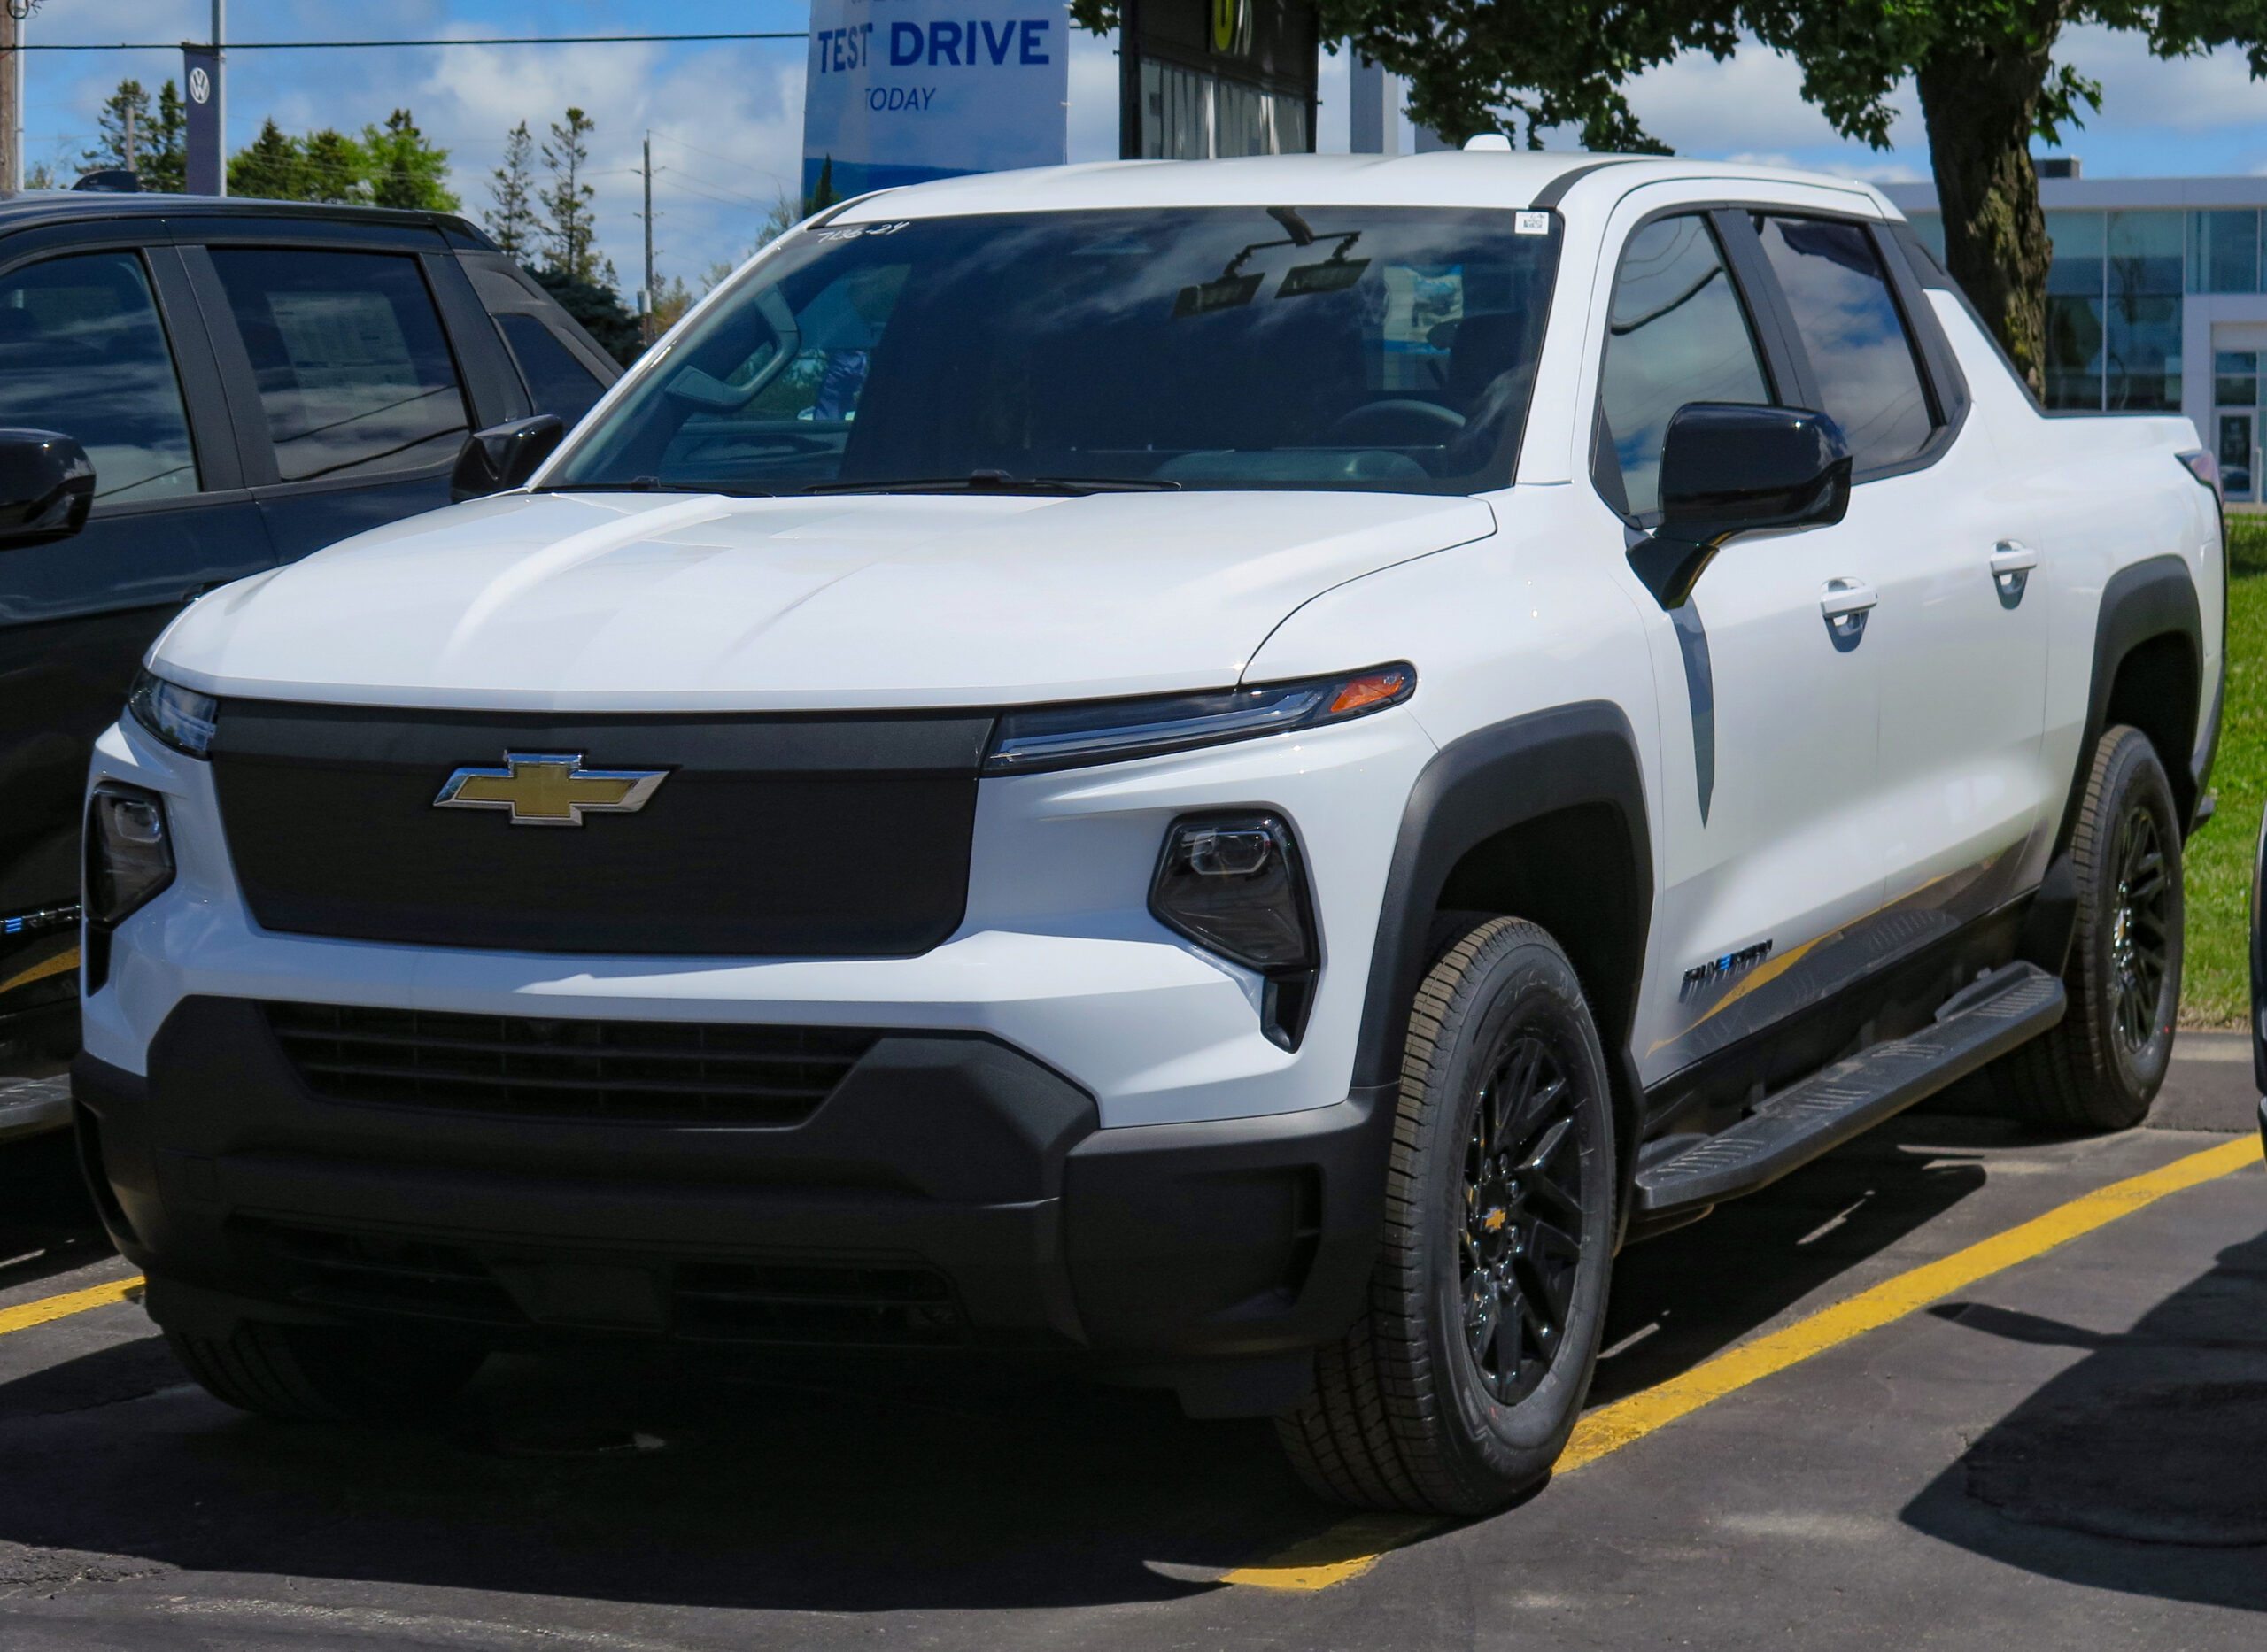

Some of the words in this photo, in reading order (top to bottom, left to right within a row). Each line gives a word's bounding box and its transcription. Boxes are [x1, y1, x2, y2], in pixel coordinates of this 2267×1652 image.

[817, 22, 873, 73] TEST
[889, 19, 1050, 66] DRIVE
[864, 87, 936, 112] TODAY
